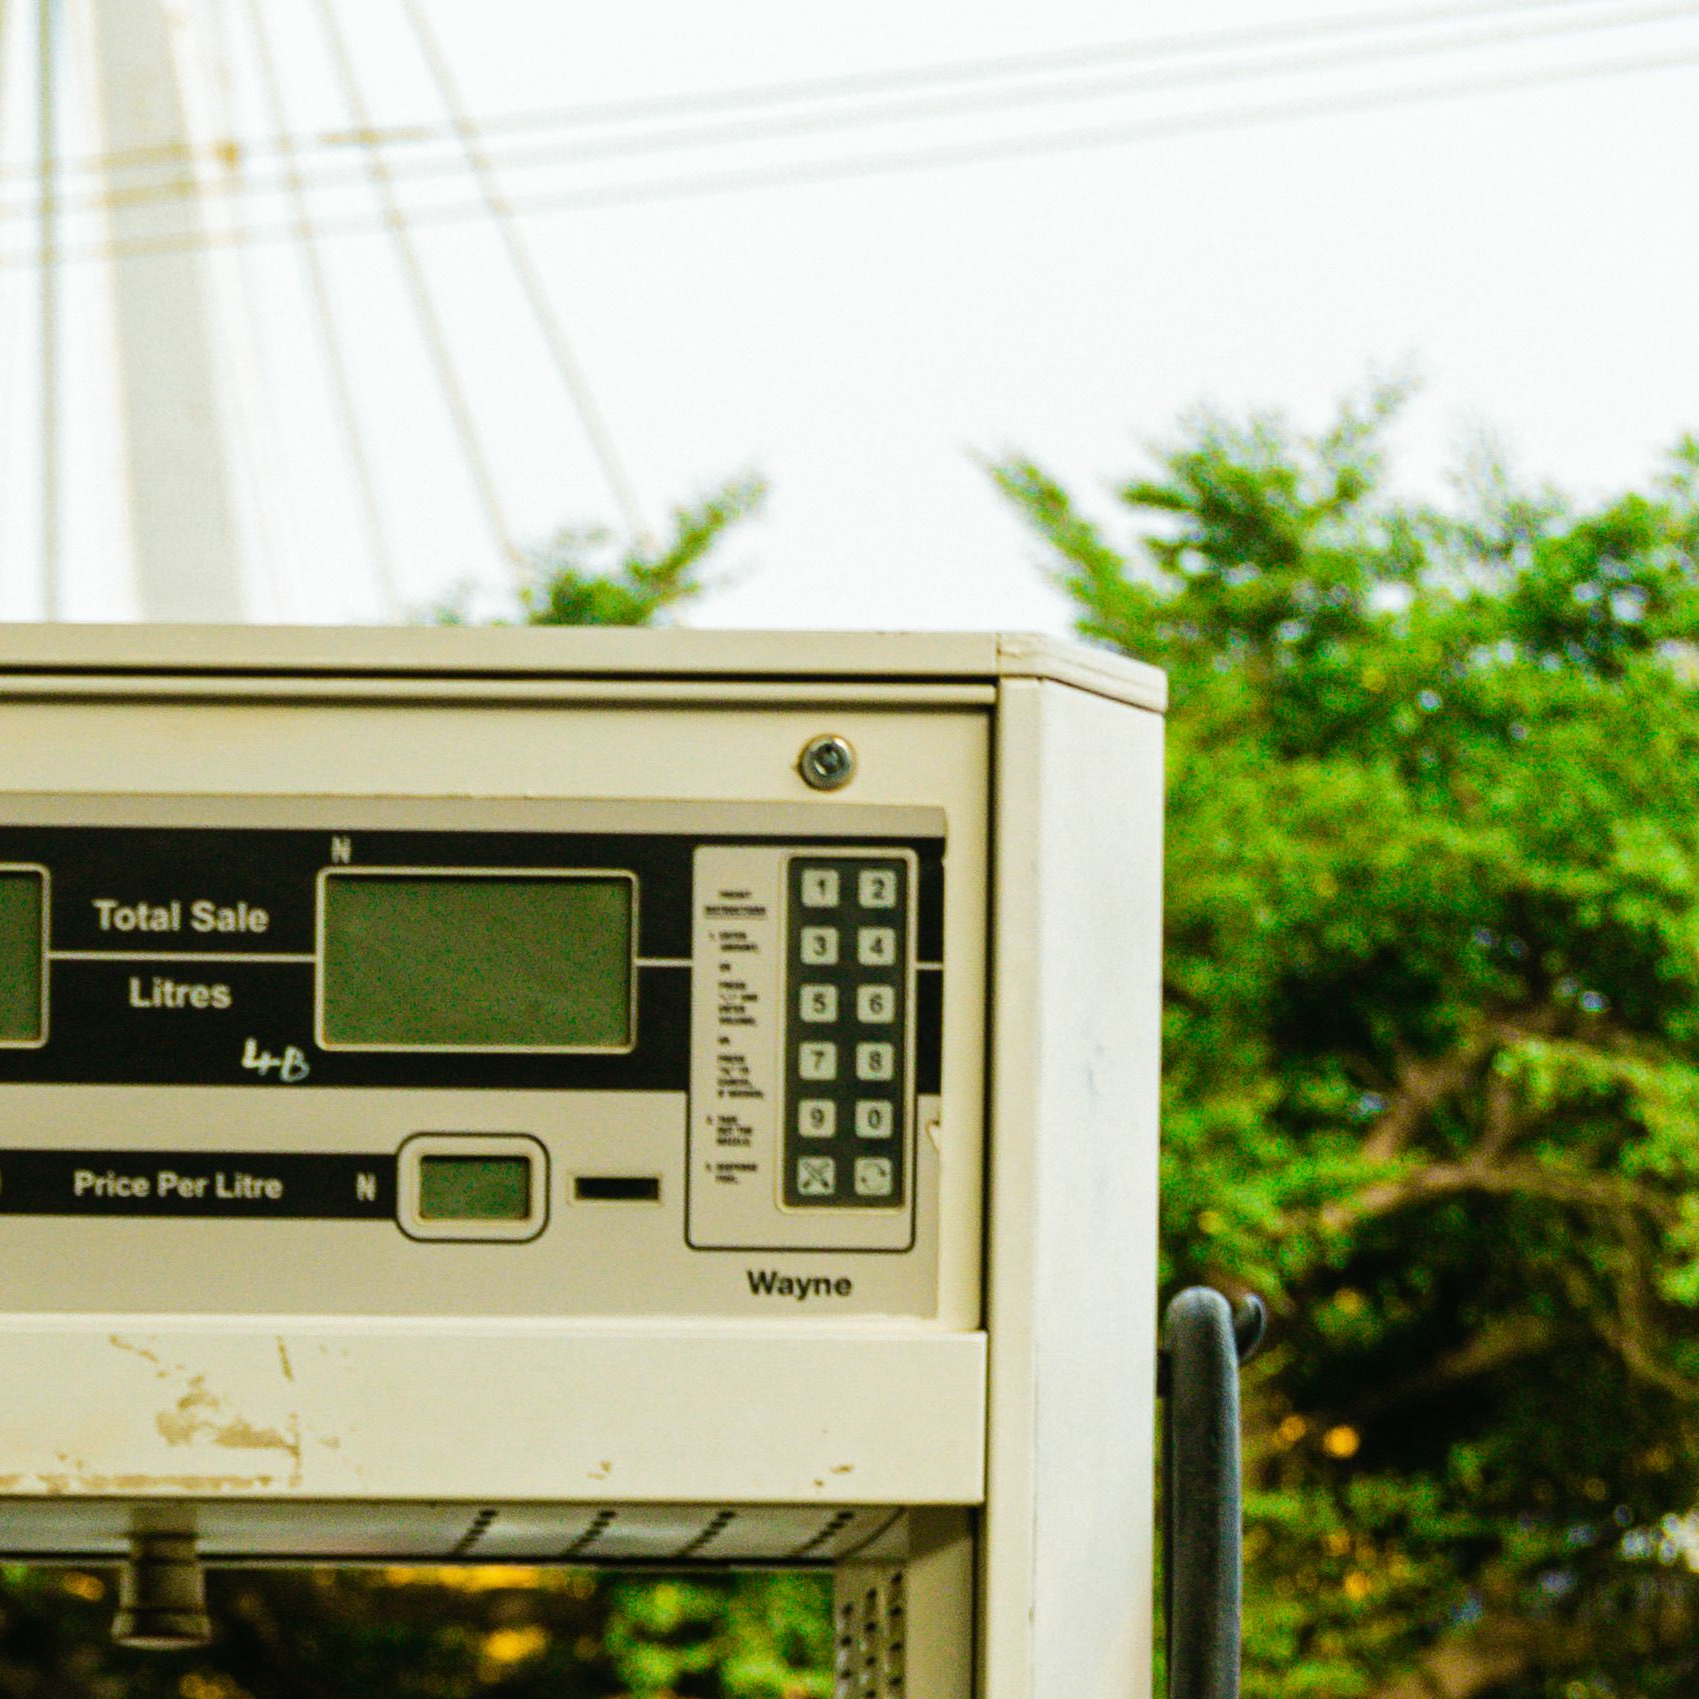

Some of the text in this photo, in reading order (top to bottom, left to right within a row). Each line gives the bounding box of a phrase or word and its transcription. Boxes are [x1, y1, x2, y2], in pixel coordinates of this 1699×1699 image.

[817, 877, 886, 900] 1 2
[92, 899, 270, 934] Total Sale
[814, 934, 884, 958] 3 4
[128, 976, 233, 1009] Litres
[812, 992, 884, 1015] 5 6
[812, 1049, 883, 1073] 7 8
[810, 1107, 883, 1130] 9 0
[73, 1168, 284, 1199] Price Per Litre
[746, 1270, 853, 1302] Wayne
